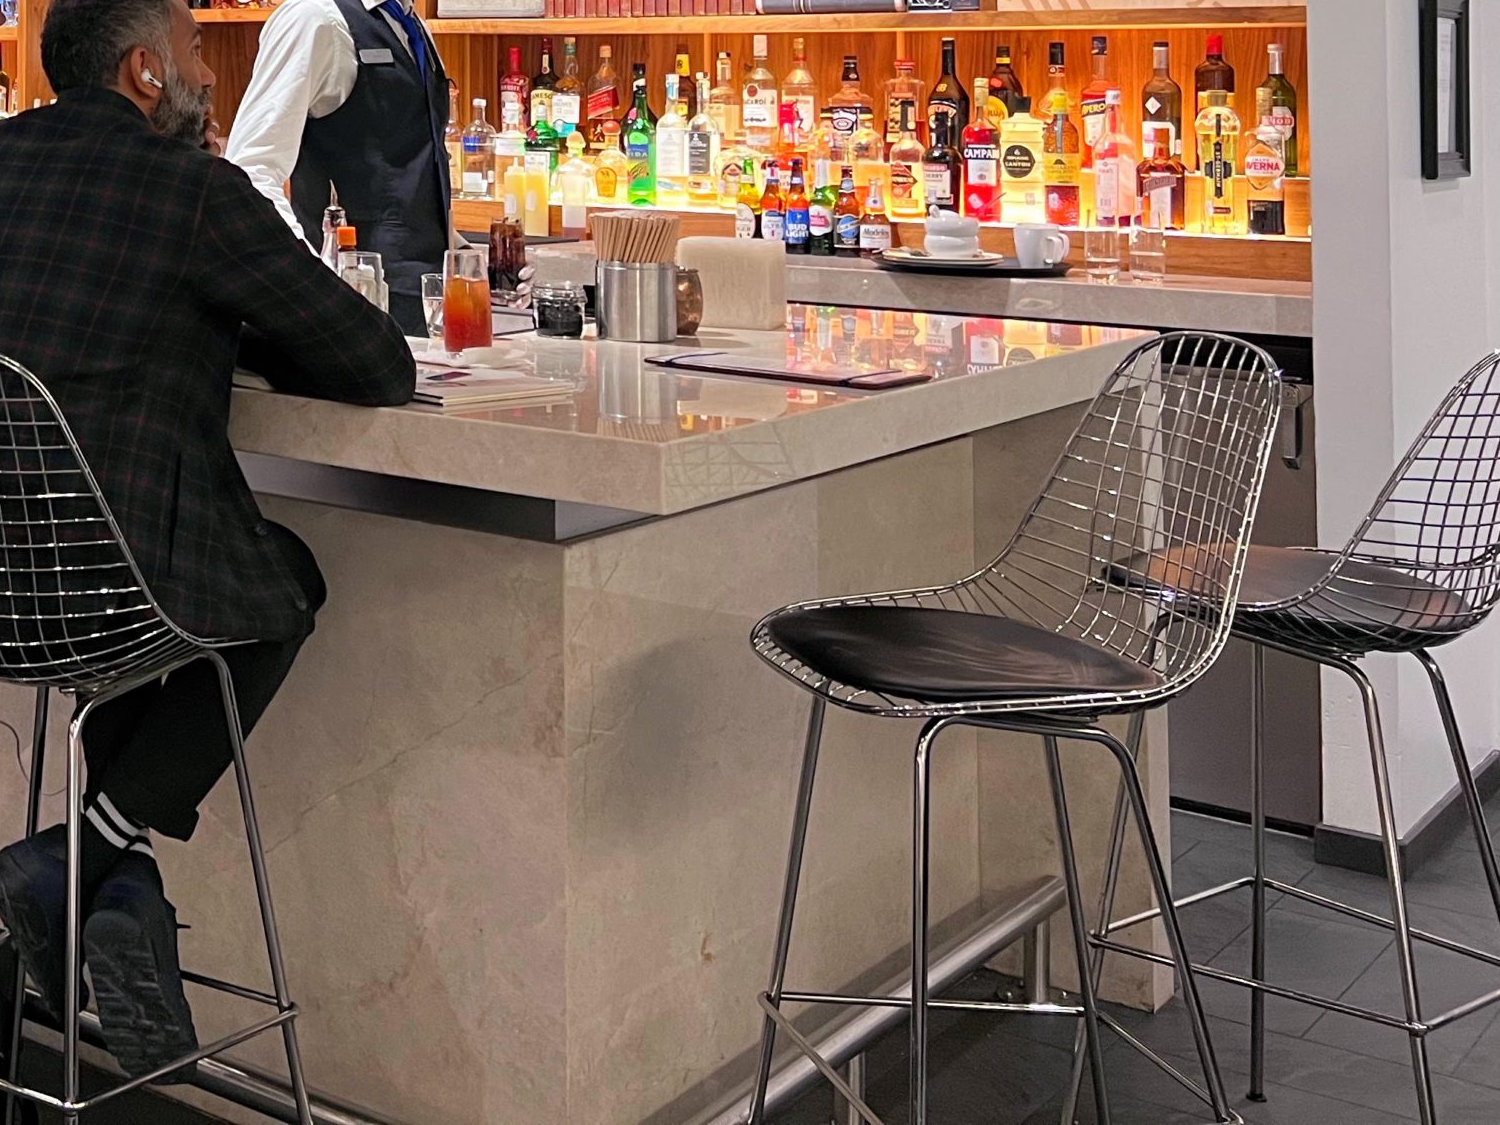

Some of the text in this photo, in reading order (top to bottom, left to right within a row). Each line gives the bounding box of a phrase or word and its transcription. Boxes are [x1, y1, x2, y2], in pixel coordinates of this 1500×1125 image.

[963, 148, 1000, 159] CAMPARI
[788, 223, 808, 232] BUD
[786, 229, 810, 238] LIGHT
